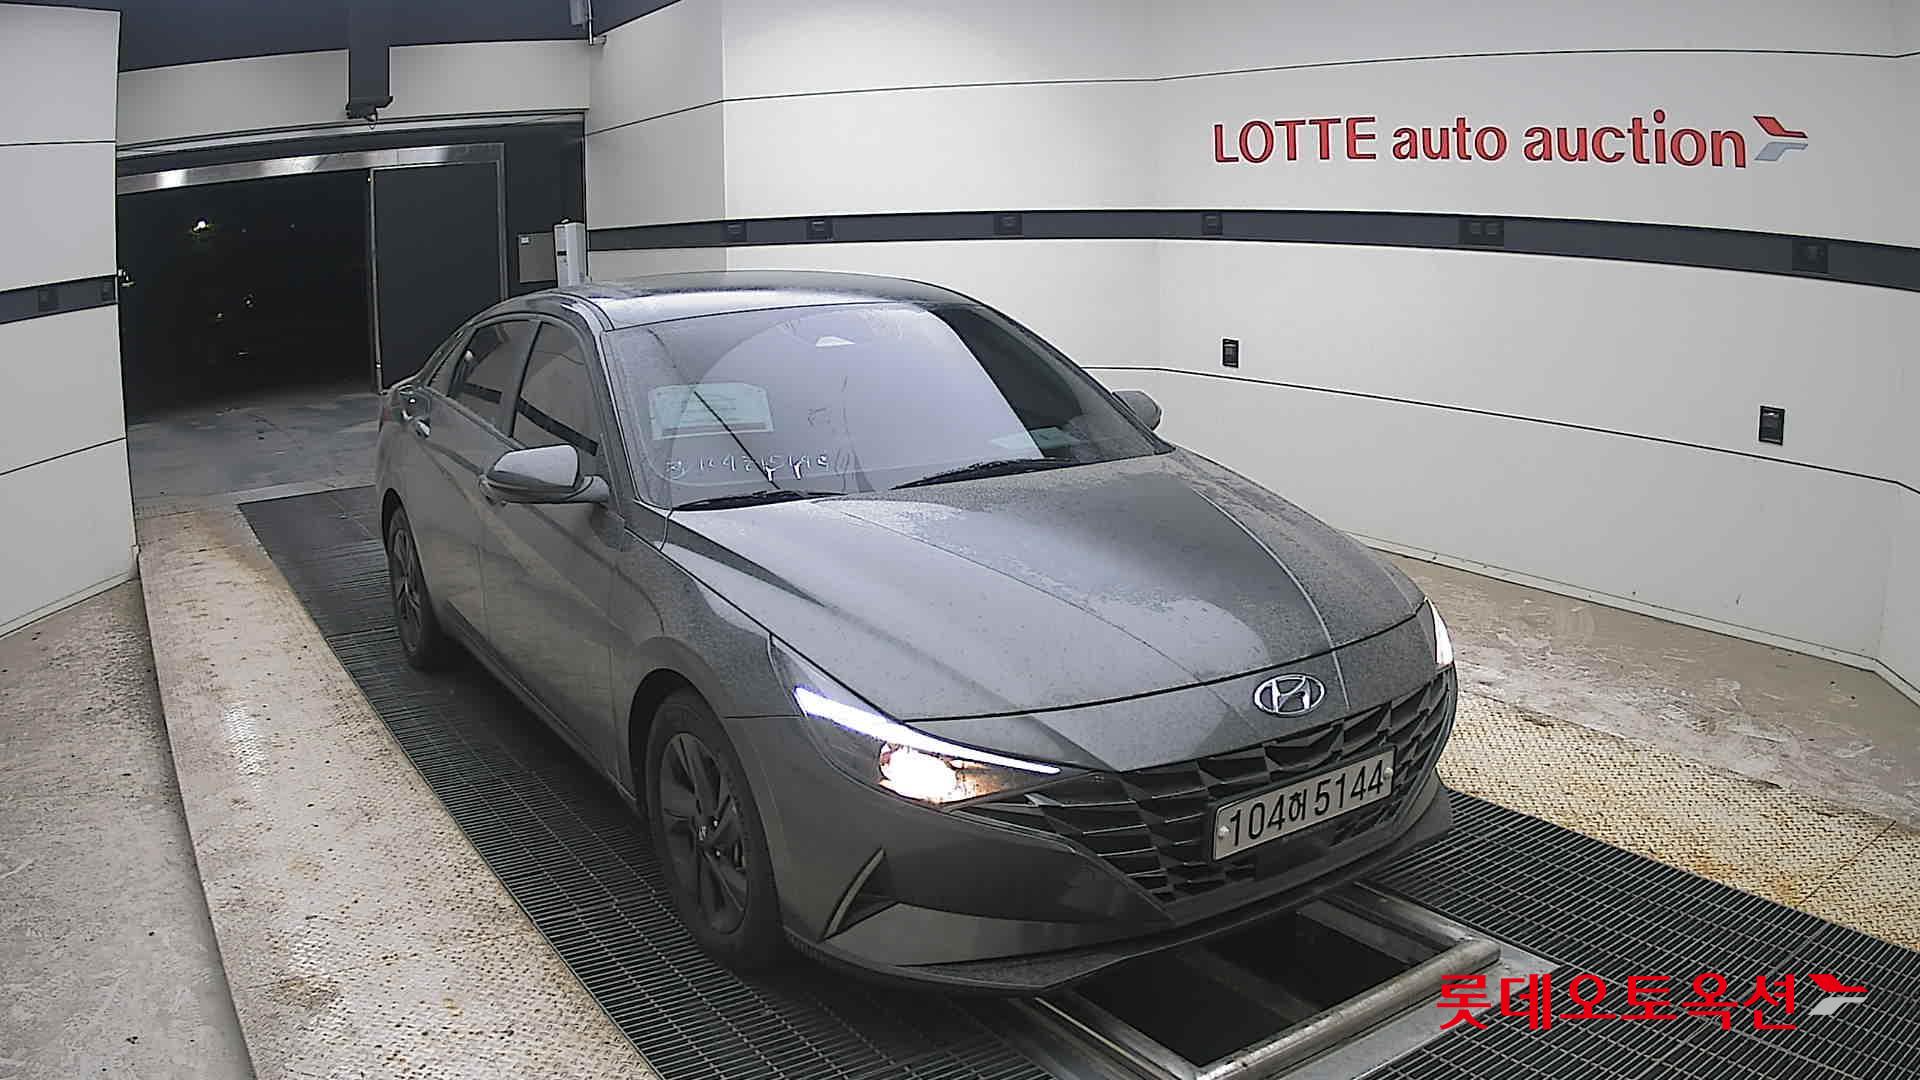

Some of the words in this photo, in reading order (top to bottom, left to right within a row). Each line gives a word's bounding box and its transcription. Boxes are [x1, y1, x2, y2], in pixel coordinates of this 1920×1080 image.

[1213, 116, 1377, 163] LOTTE
[1392, 116, 1509, 161] auto
[1522, 109, 1748, 168] auction
